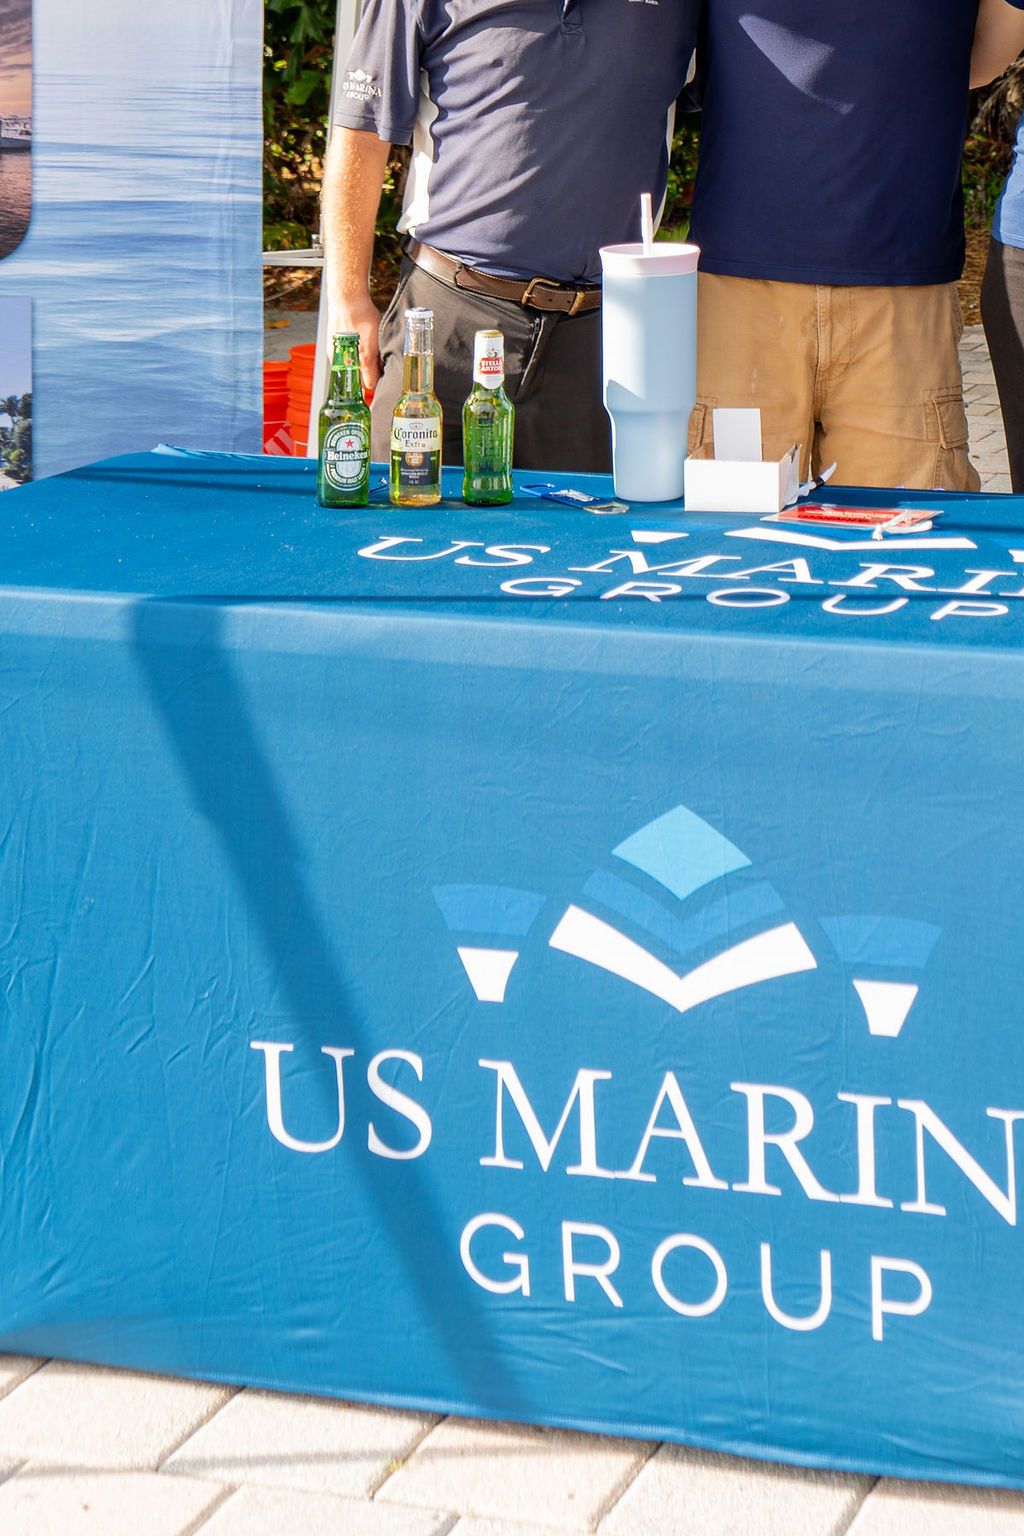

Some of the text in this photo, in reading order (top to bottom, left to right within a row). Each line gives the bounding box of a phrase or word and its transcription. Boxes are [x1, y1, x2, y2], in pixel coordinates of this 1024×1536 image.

[326, 450, 368, 461] Heineken
[357, 536, 551, 567] US
[499, 577, 1009, 621] GROUP
[250, 1040, 433, 1160] US
[459, 1212, 933, 1341] GROUP
